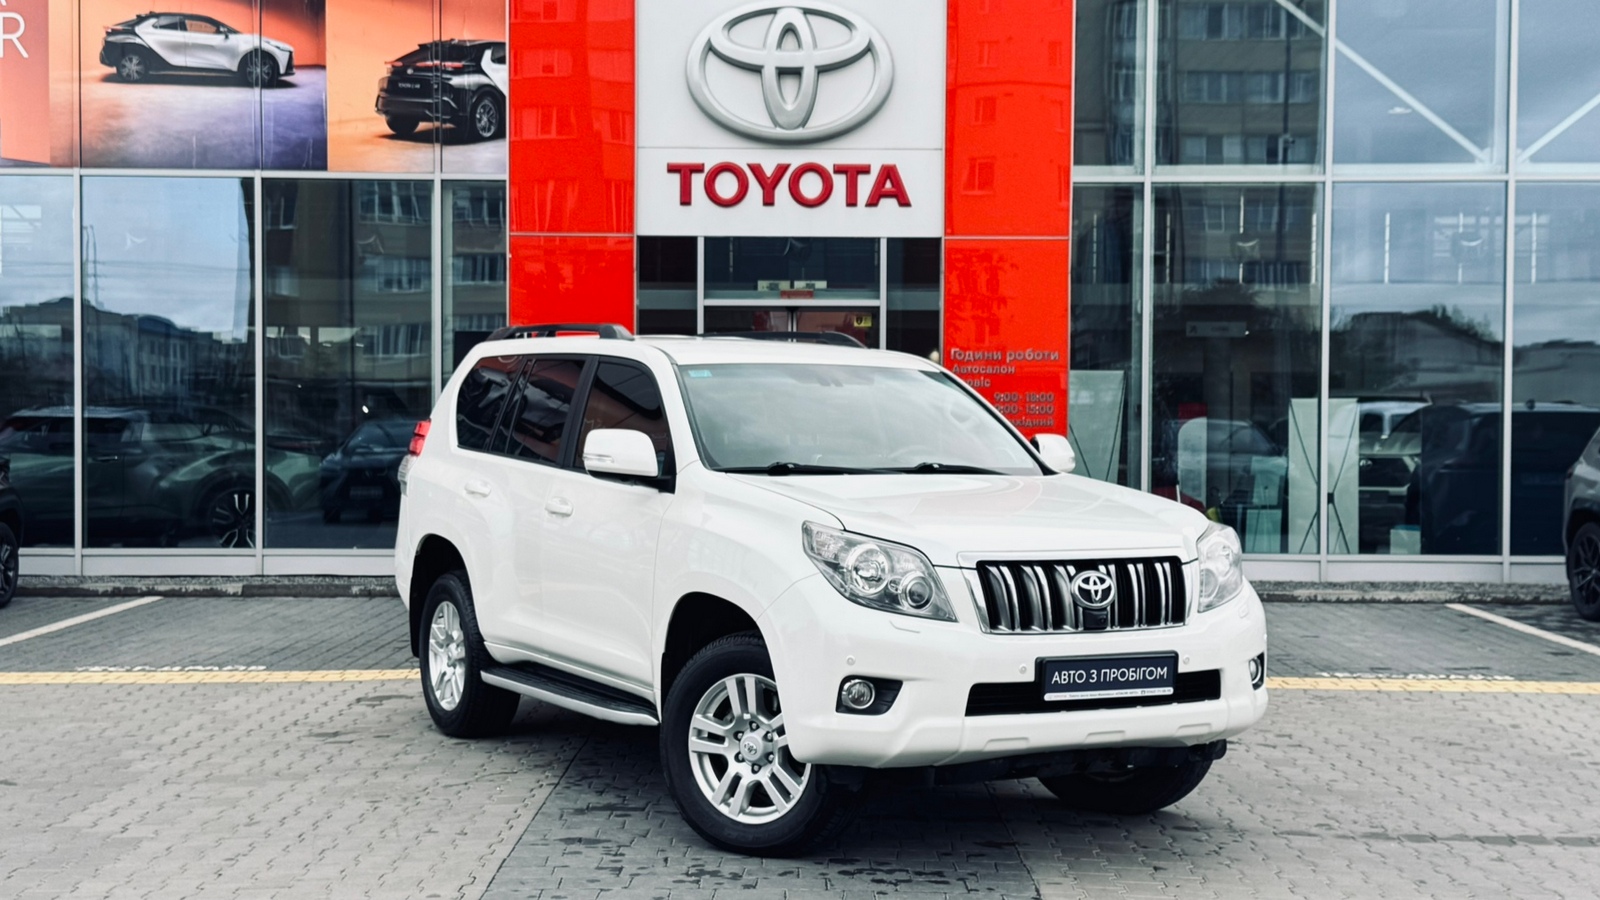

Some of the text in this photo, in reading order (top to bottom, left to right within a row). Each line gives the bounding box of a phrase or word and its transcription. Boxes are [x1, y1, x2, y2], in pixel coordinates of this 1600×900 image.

[667, 161, 912, 208] TOYOTA
[950, 348, 1059, 363] Години роботи
[952, 364, 1015, 374] Автосалон
[1051, 669, 1086, 685] АВТО
[1100, 666, 1168, 682] ПРОБІГОМ
